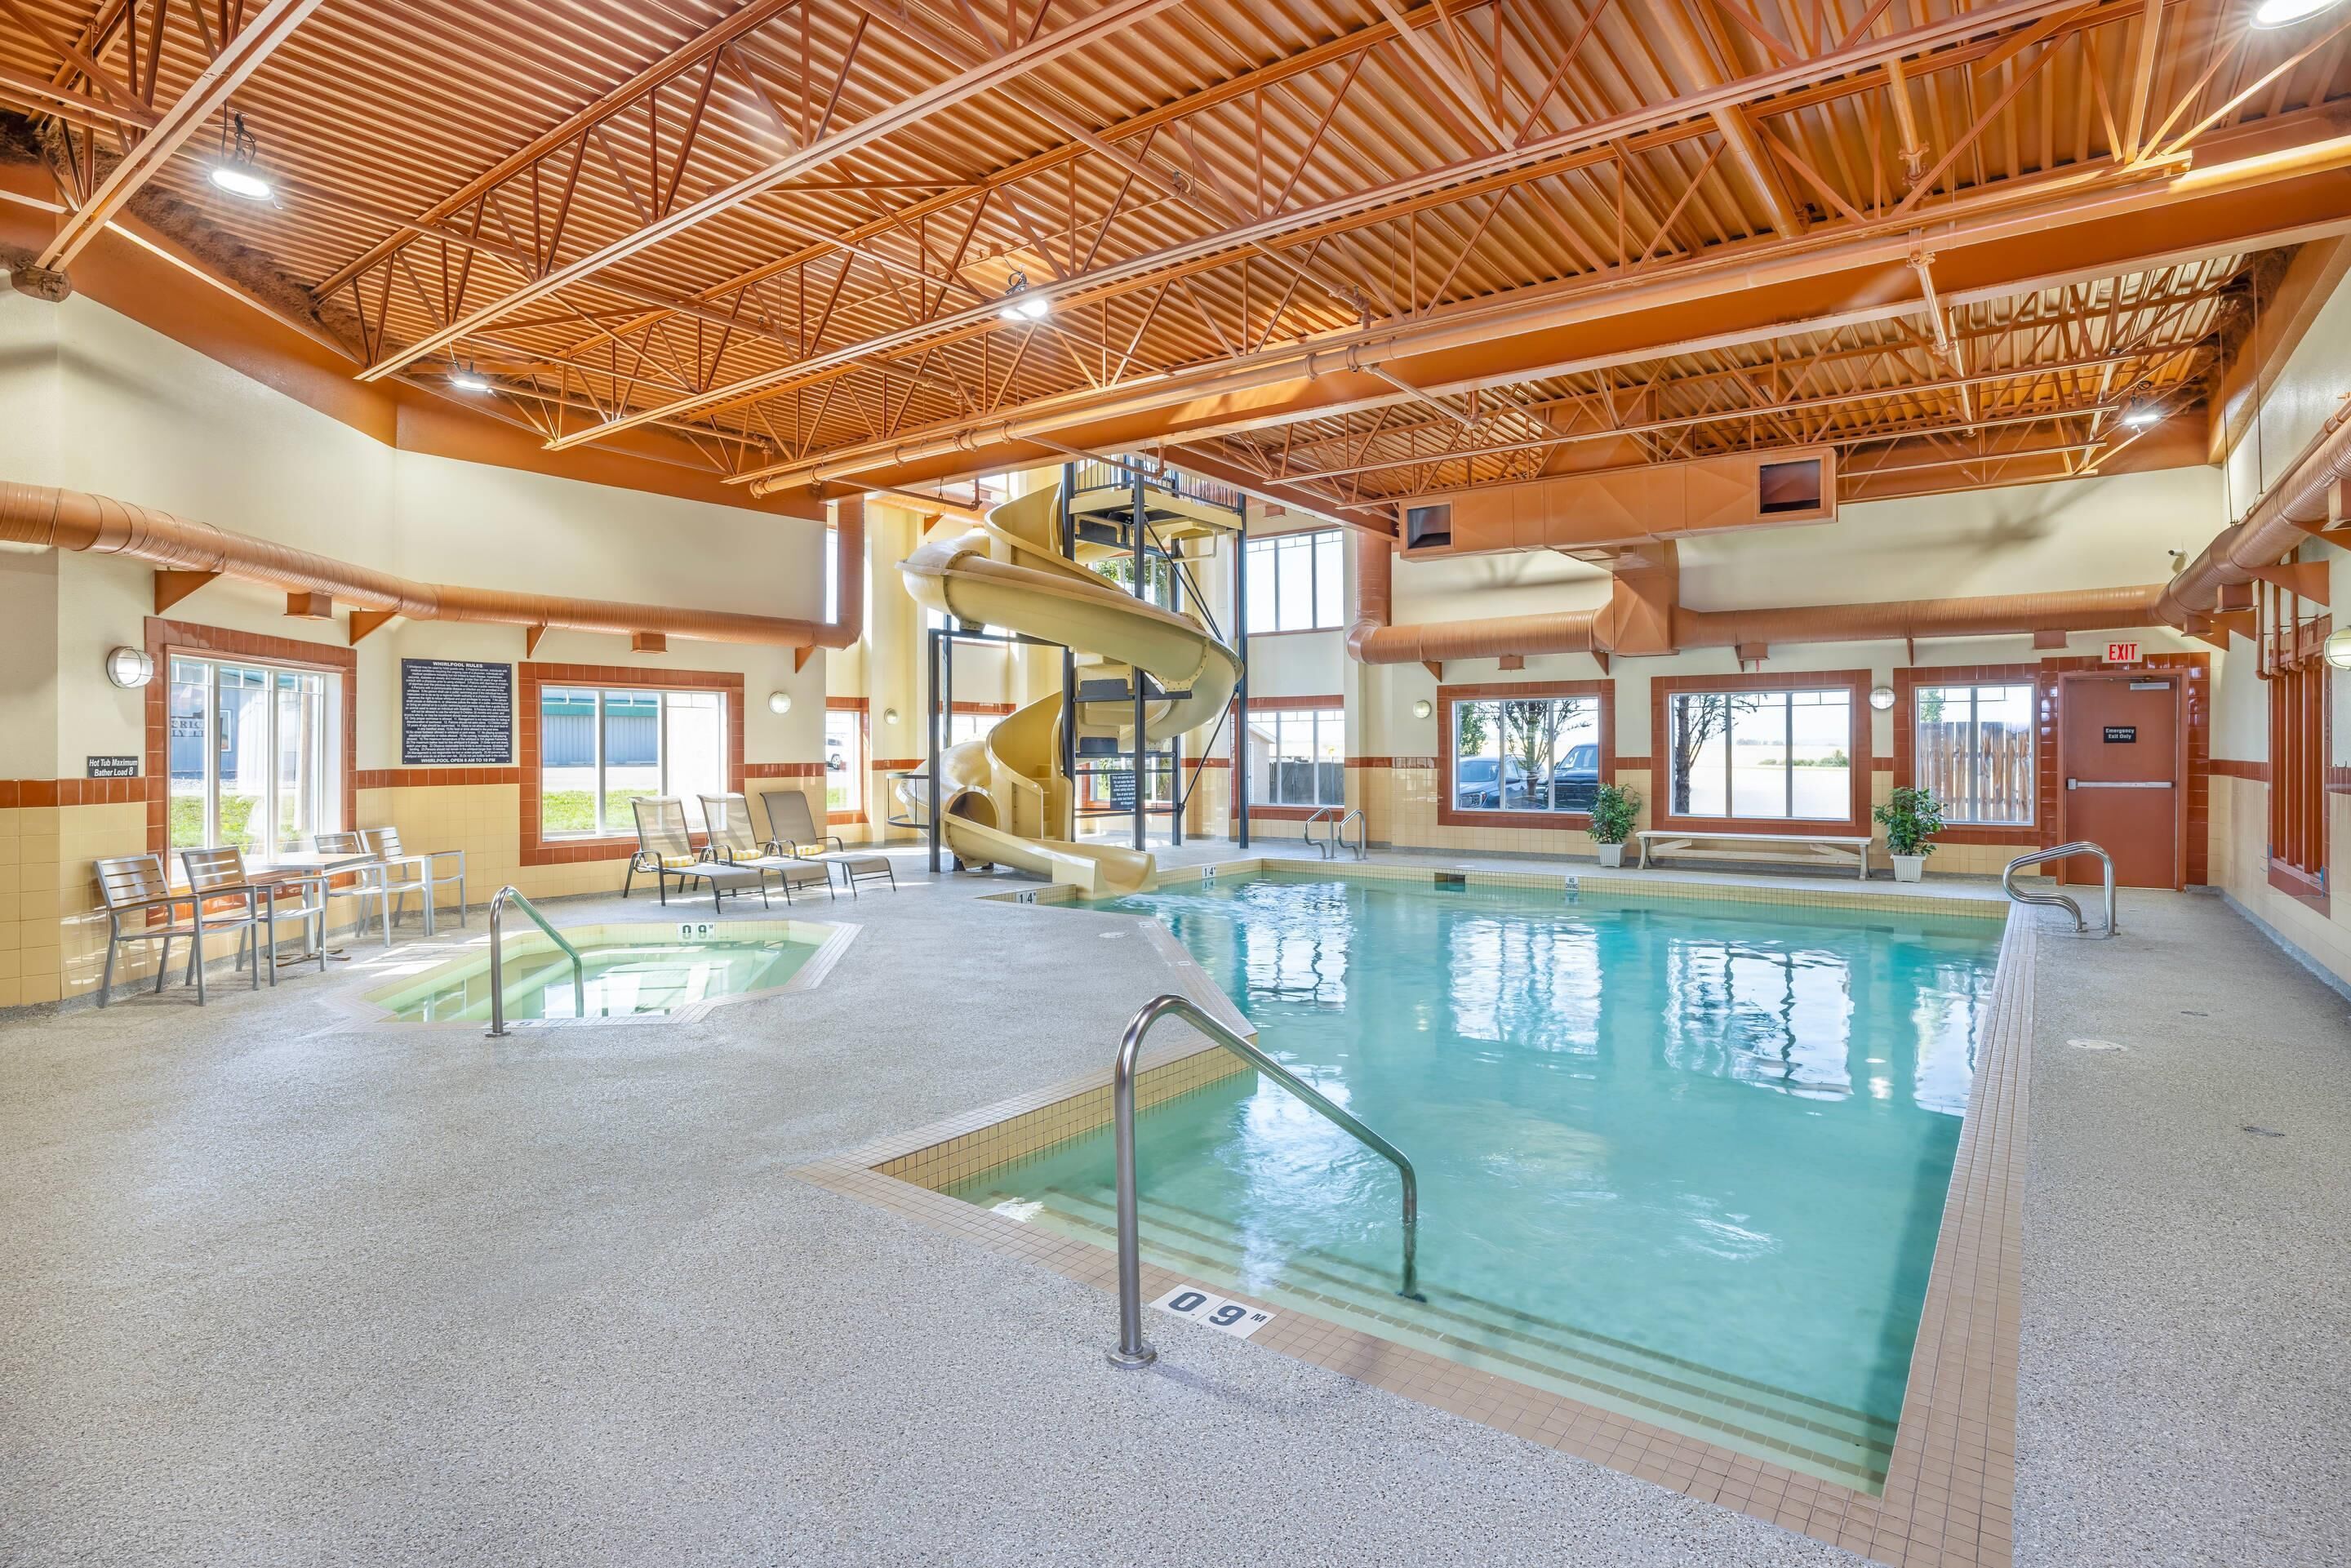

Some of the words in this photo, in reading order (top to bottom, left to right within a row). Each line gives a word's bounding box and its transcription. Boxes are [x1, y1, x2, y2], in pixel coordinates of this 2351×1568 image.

[2109, 643, 2137, 660] EXIT
[89, 758, 100, 766] Hot
[100, 758, 111, 766] Tub
[111, 758, 138, 766] Maximum
[94, 768, 113, 777] Bather
[113, 768, 128, 776] Load
[128, 766, 134, 775] 8
